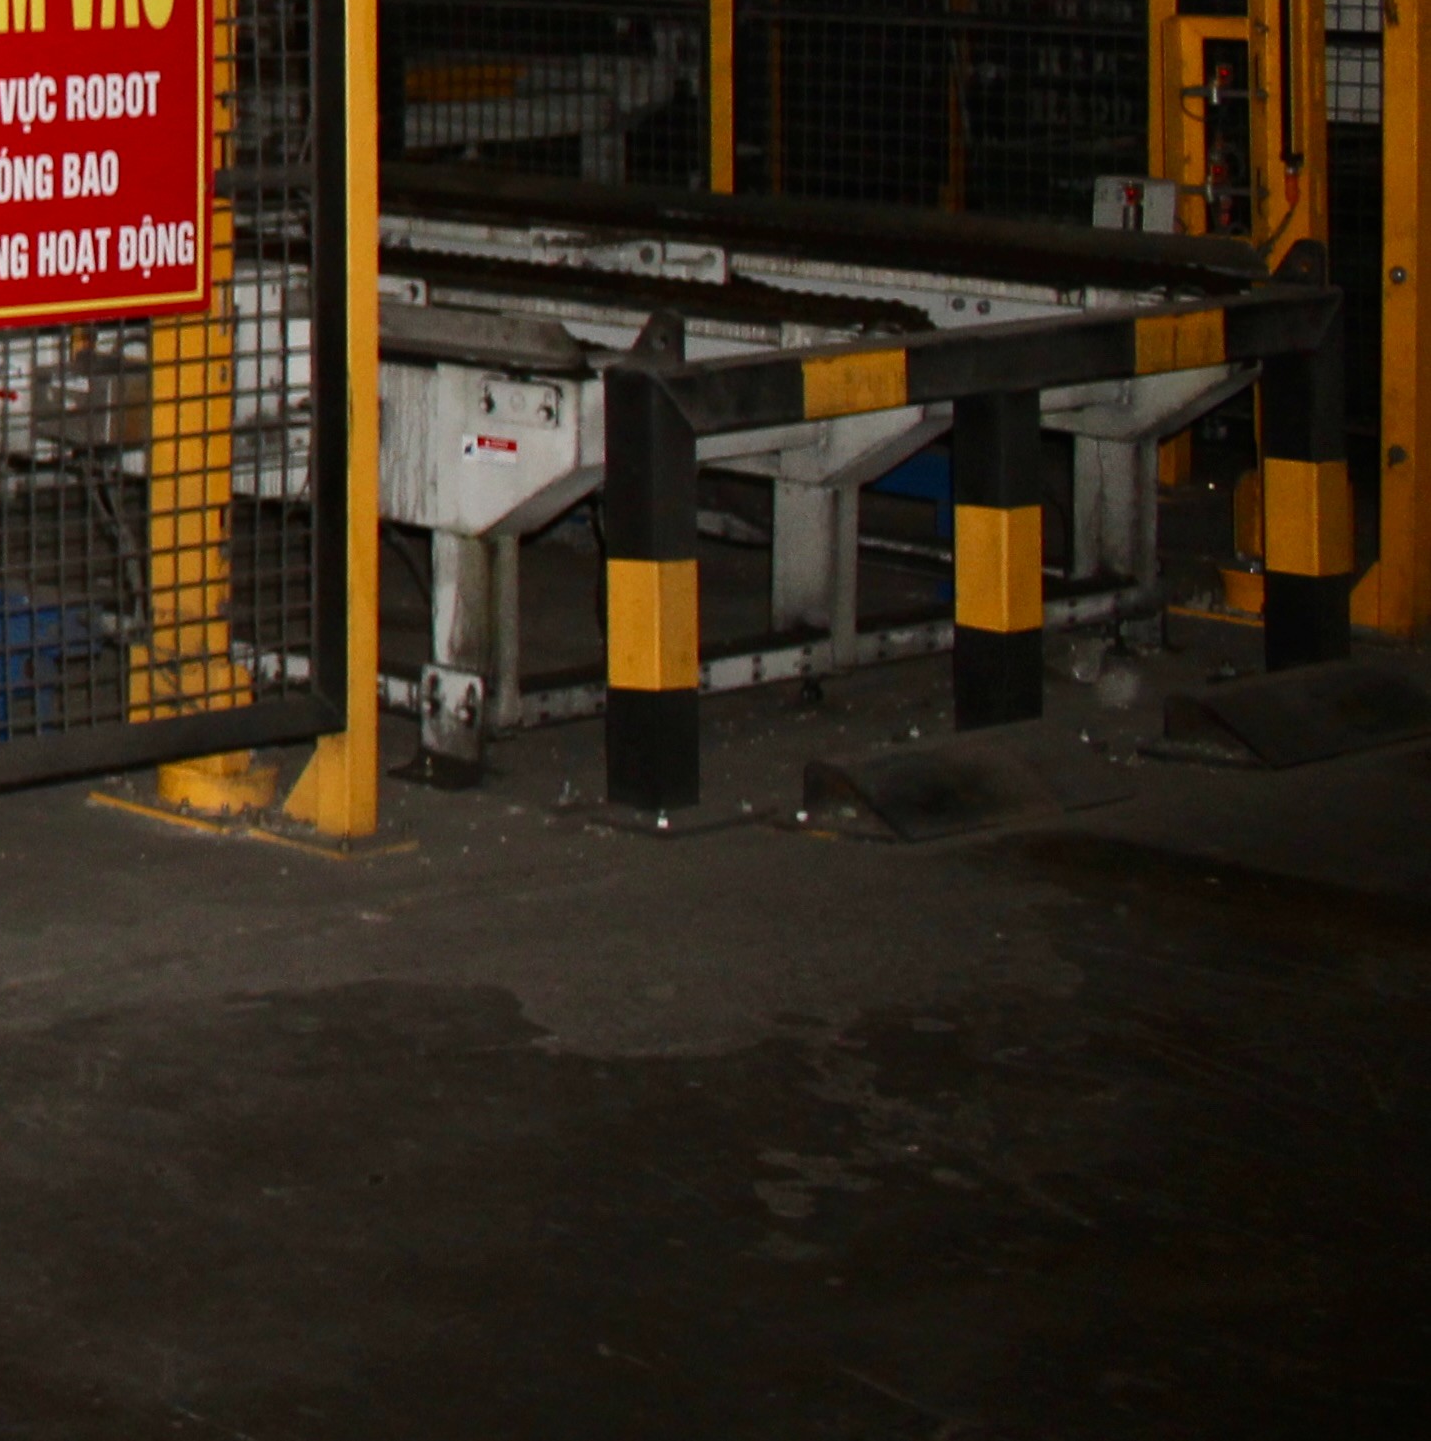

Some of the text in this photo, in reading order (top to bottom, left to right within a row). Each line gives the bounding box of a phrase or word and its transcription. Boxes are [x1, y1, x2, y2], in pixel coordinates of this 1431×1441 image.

[66, 71, 161, 121] ROBOT
[62, 150, 119, 198] BAO
[38, 227, 111, 283] HOẠT
[118, 214, 195, 279] ĐỘNG
